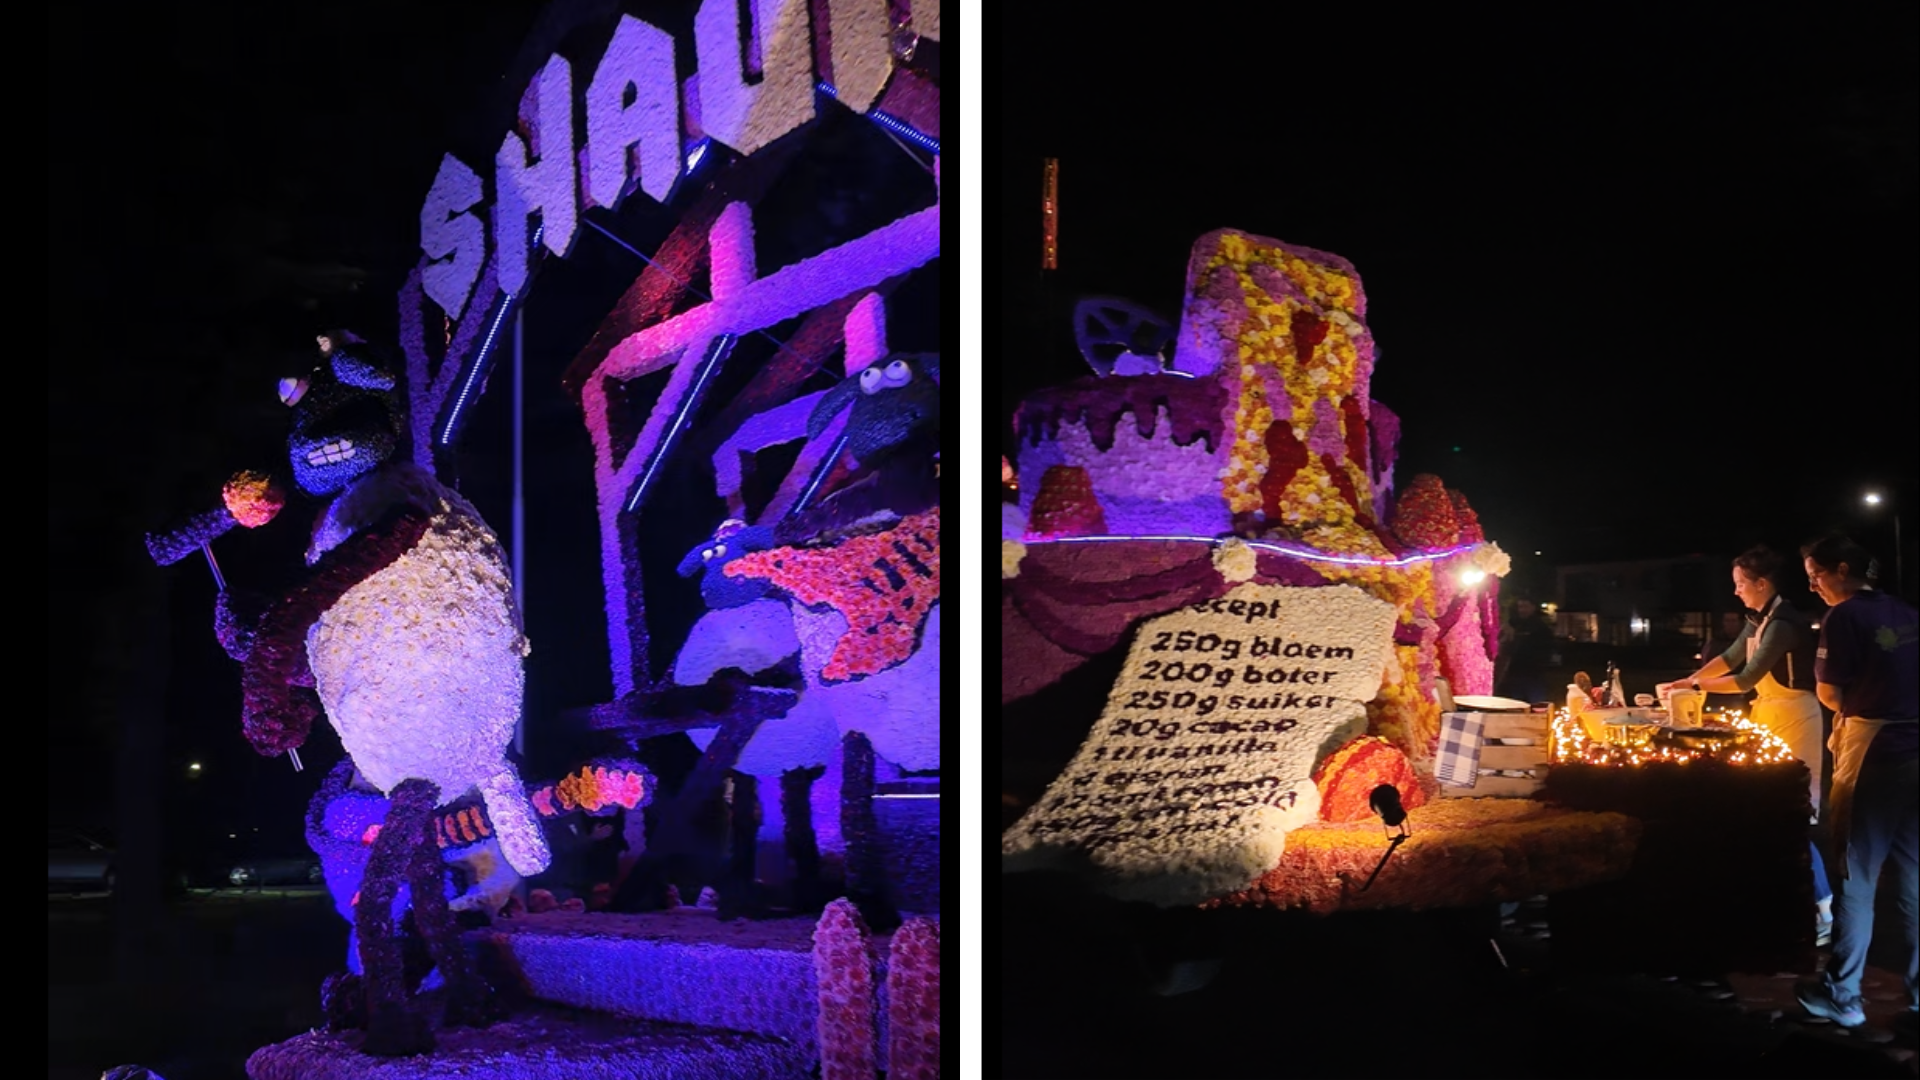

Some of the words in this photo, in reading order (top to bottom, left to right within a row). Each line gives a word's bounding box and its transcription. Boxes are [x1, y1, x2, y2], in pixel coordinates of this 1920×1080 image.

[1191, 598, 1282, 624] ecept
[1150, 631, 1242, 659] 250g
[1250, 635, 1354, 659] bloem
[1138, 660, 1234, 687] 200g
[1242, 663, 1338, 684] boter
[1123, 691, 1219, 715] 250g
[1226, 691, 1337, 710] suiker
[1109, 718, 1180, 740] 20g
[1187, 718, 1298, 734] cacao
